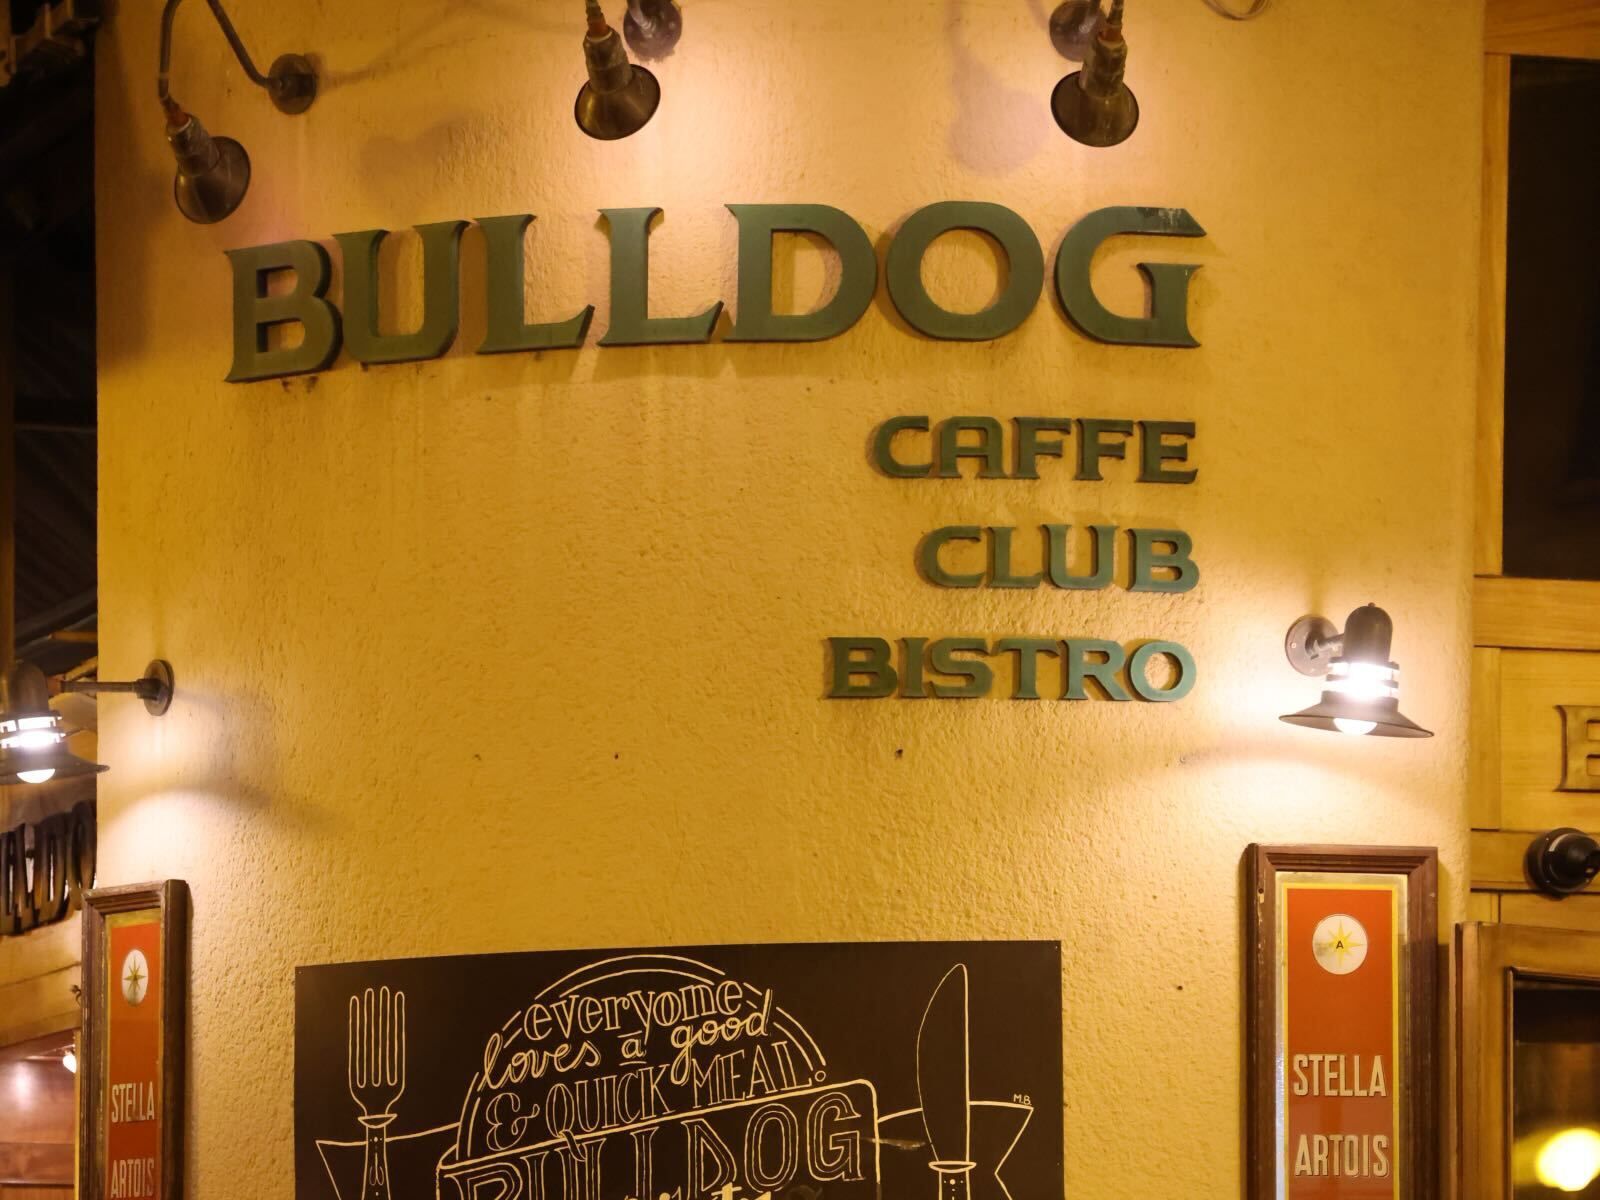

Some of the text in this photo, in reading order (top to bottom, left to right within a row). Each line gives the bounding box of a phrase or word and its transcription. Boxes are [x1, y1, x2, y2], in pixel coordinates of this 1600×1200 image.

[223, 201, 1208, 384] BULLDOG
[870, 414, 1199, 485] CAFFE
[915, 524, 1201, 594] CLUB
[825, 636, 1199, 703] BISTRO
[477, 988, 773, 1090] loves a good
[523, 980, 744, 1045] everyone
[111, 1081, 155, 1123] STELLA
[1293, 1053, 1387, 1097] STELLA
[486, 1092, 541, 1150] &
[545, 1063, 675, 1158] QUICK
[110, 1158, 155, 1199] ARTOIS
[1294, 1133, 1389, 1178] ARTOIS
